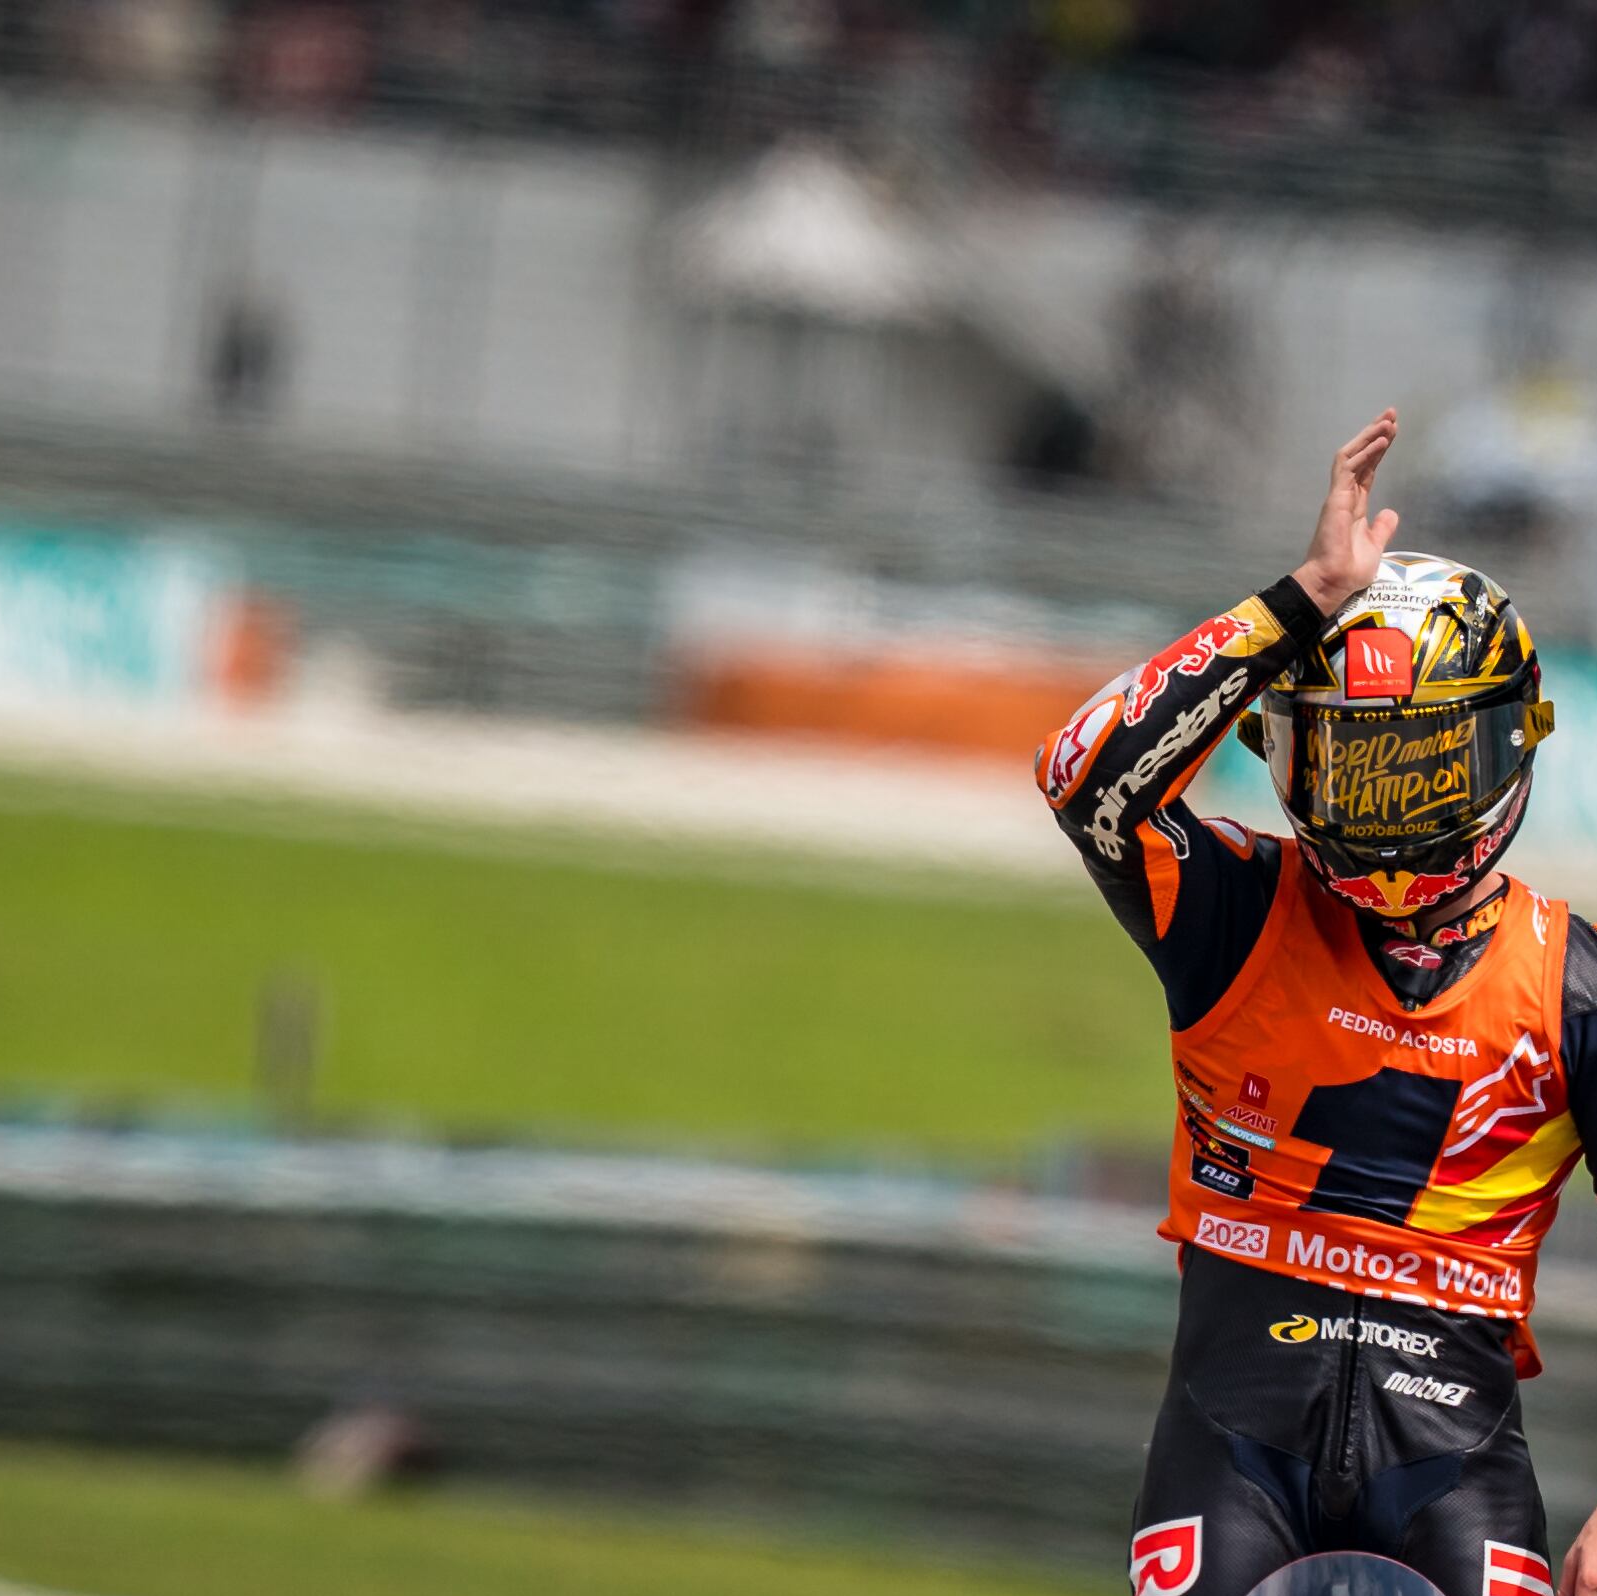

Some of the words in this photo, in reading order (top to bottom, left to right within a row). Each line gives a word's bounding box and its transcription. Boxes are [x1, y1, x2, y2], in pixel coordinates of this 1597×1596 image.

[1354, 710, 1392, 723] YOU
[1084, 667, 1249, 861] alpinestars
[1343, 820, 1438, 837] MOTOBLOUZ
[1328, 1007, 1396, 1042] PEDRO
[1399, 1030, 1479, 1058] ACOSTA
[1222, 1105, 1279, 1135] AVANT
[1228, 1125, 1272, 1150] MOTOREX
[1290, 1065, 1464, 1227] 1
[1200, 1217, 1265, 1254] 2023
[1286, 1229, 1423, 1286] Moto2
[1434, 1255, 1522, 1302] World
[1320, 1316, 1445, 1360] MOTOREX
